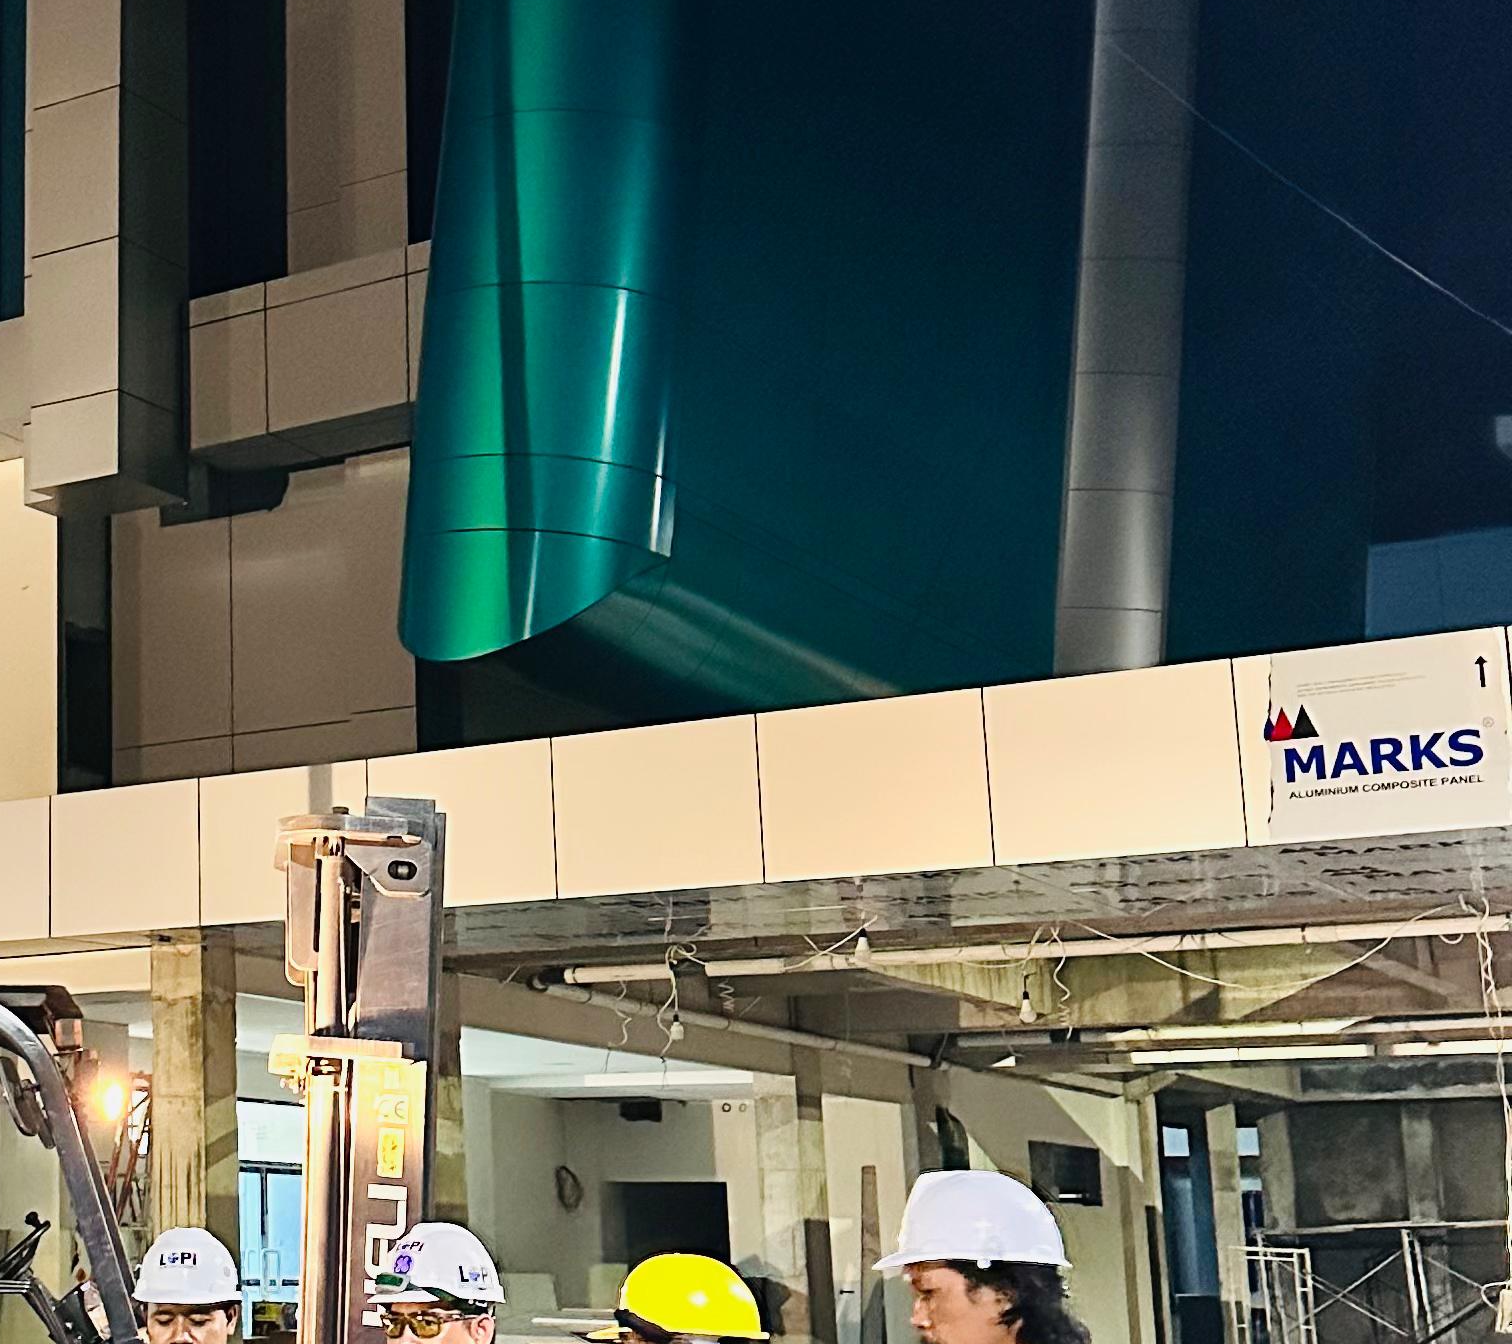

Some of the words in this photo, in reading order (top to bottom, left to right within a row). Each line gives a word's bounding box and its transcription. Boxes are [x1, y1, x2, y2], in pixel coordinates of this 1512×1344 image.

[1284, 728, 1484, 784] MARKS
[1289, 785, 1359, 800] ALUMINIUM
[1362, 777, 1437, 793] COMPOSITE
[1440, 773, 1485, 786] PANEL
